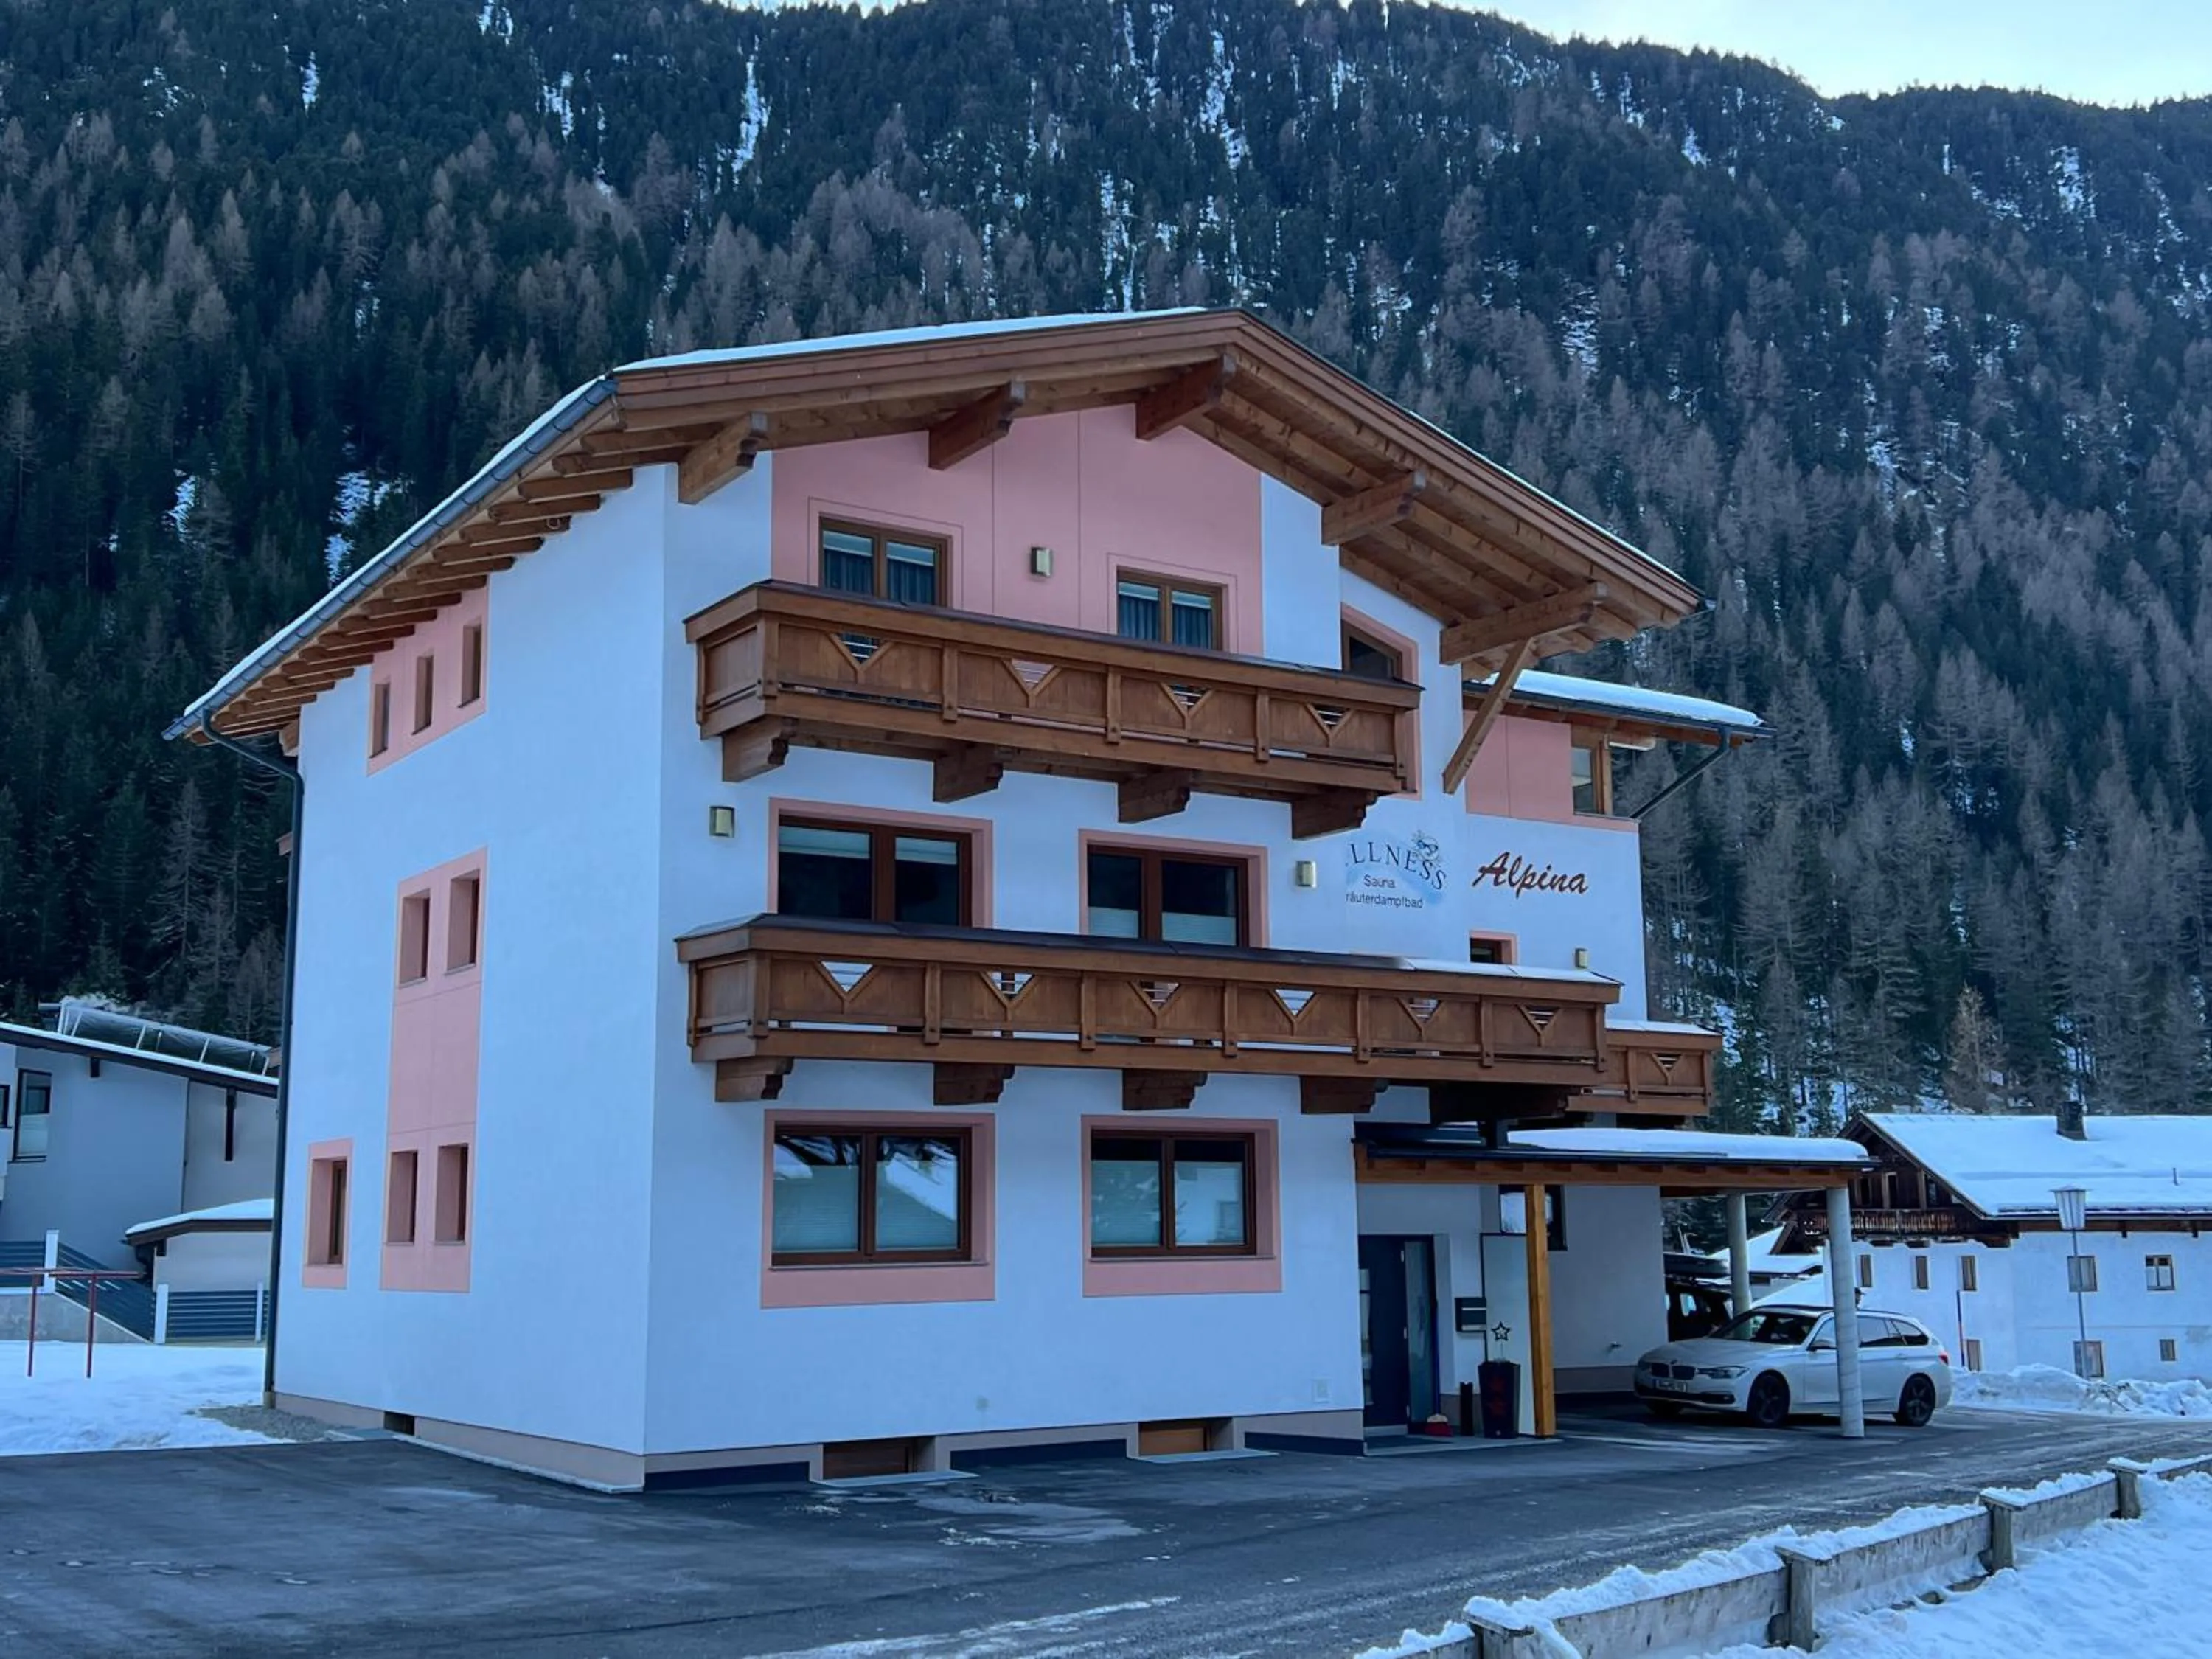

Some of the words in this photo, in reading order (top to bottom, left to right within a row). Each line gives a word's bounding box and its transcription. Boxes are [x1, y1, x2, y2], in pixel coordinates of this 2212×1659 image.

[1349, 841, 1447, 891] LLNESS
[1363, 874, 1397, 888] Sauna
[1472, 851, 1589, 899] Alpina
[1345, 891, 1424, 909] räuterdampfbad
